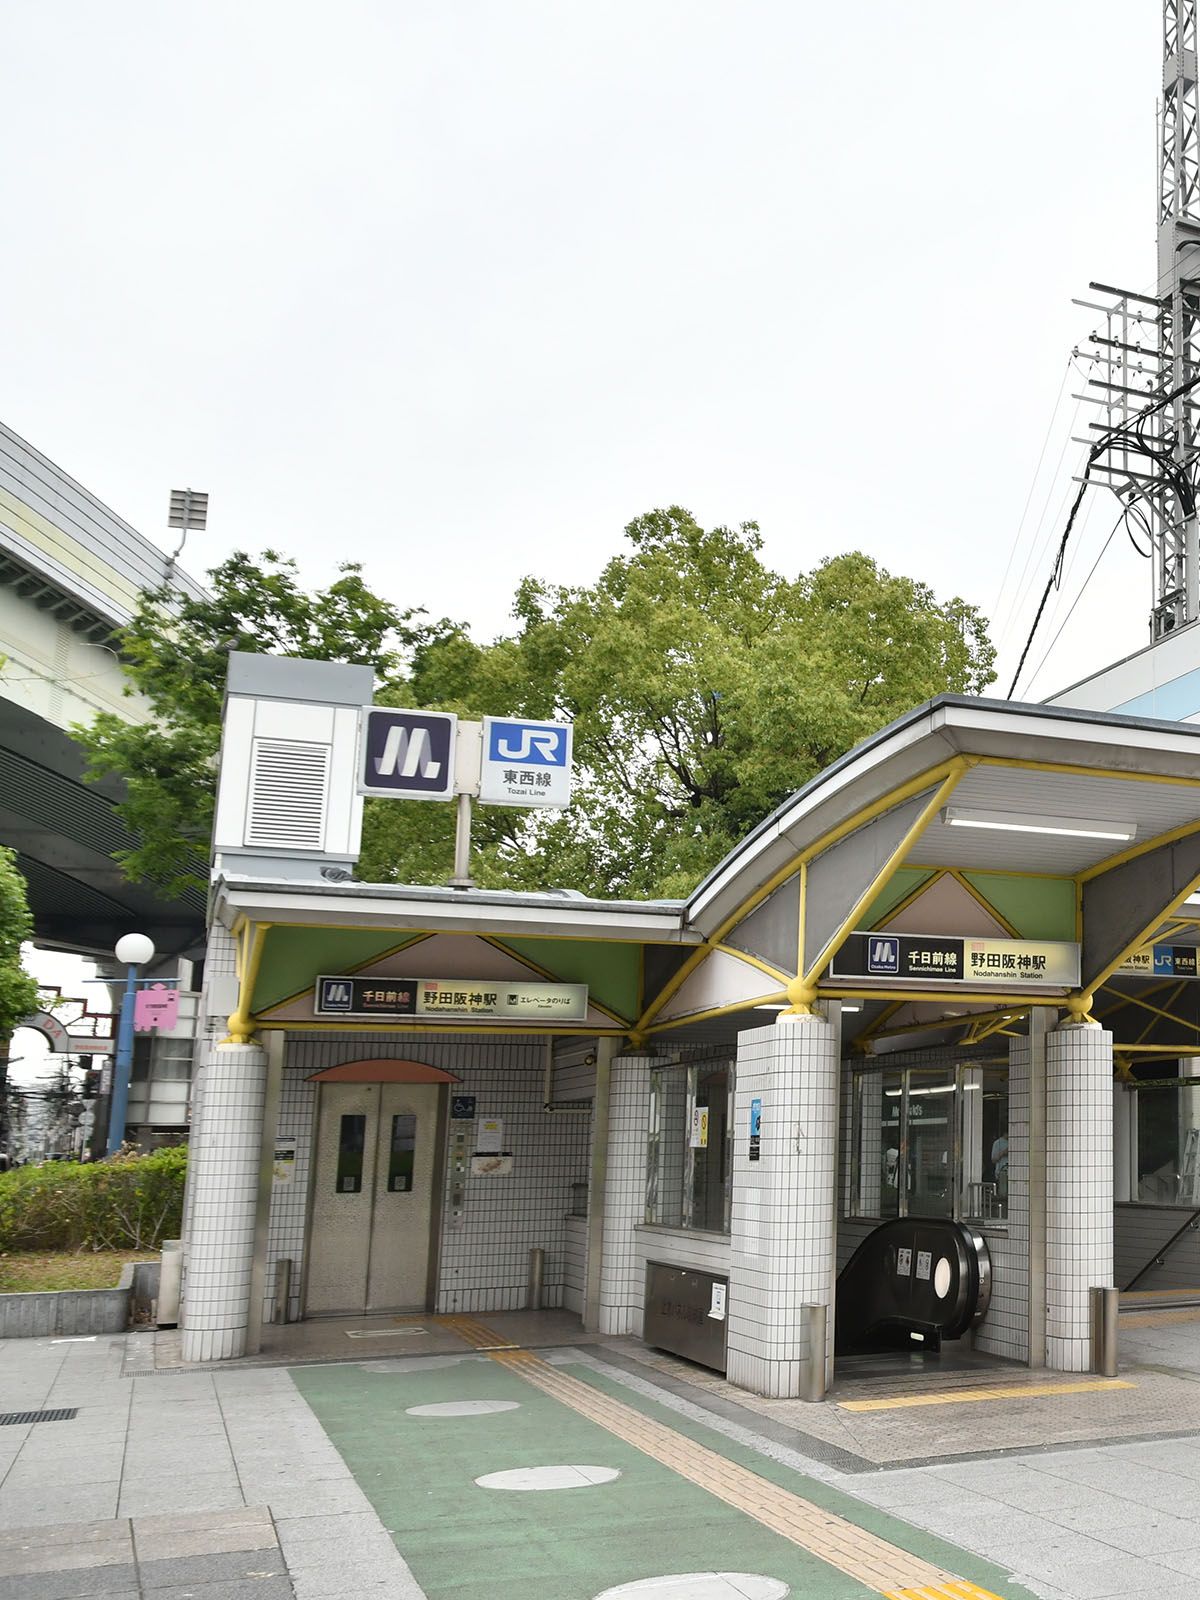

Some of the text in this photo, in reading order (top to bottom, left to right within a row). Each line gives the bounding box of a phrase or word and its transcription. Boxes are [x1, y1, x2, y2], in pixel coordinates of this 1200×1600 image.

[497, 729, 560, 762] JR
[503, 769, 552, 787] 東西線
[507, 787, 527, 795] Tozai
[908, 951, 957, 966] 千日前線
[971, 952, 1046, 970] 野田阪神駅
[1154, 955, 1172, 966] JR
[1174, 957, 1196, 966] 東西線
[909, 965, 943, 973] Sennichimae
[973, 970, 1017, 978] Nodahanshin
[362, 990, 411, 1003] 千日前線
[423, 991, 497, 1006] 野田阪神駅
[520, 996, 571, 1005] エレベータのりば
